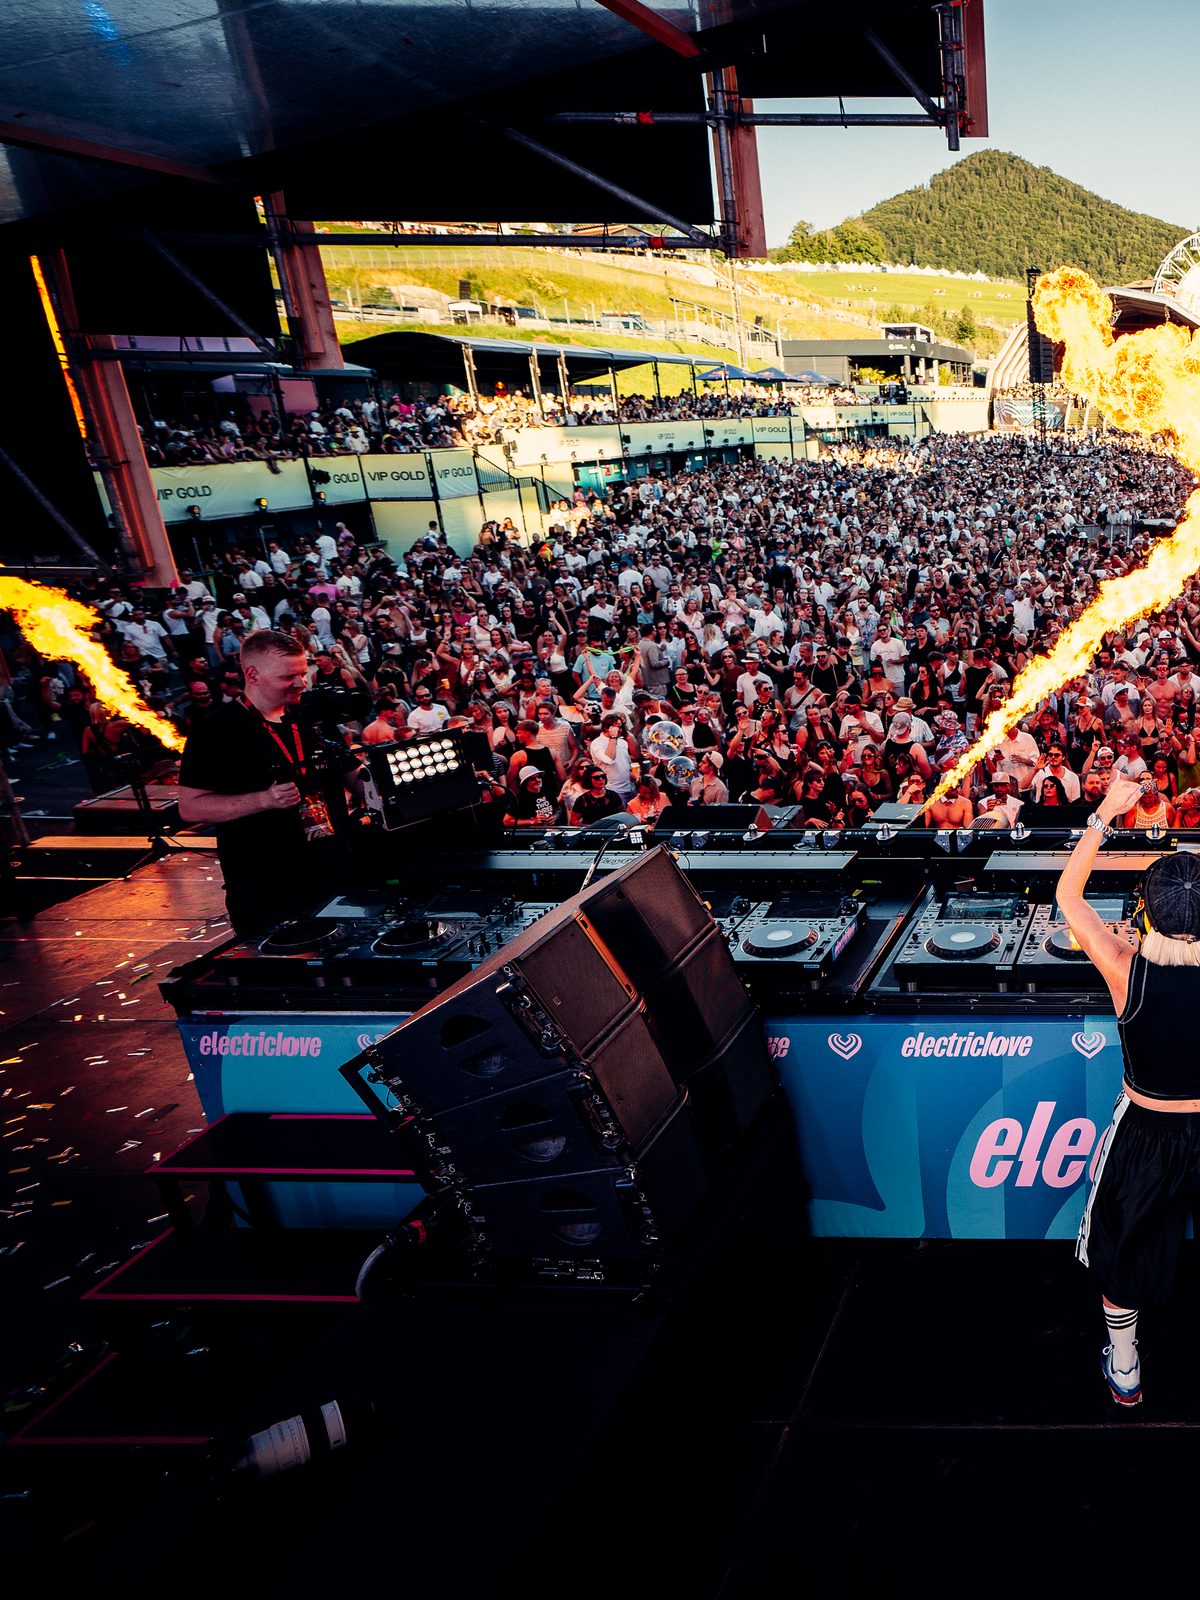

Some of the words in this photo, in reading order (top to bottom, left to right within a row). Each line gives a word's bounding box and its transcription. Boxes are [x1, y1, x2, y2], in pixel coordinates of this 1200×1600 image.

[333, 473, 360, 484] GOLD
[367, 471, 388, 481] VIP
[390, 471, 425, 481] GOLD
[436, 468, 450, 479] VIP
[451, 466, 473, 477] GOLD
[176, 485, 212, 499] GOLD
[200, 1031, 322, 1057] electriclove
[901, 1031, 1033, 1058] electriclove
